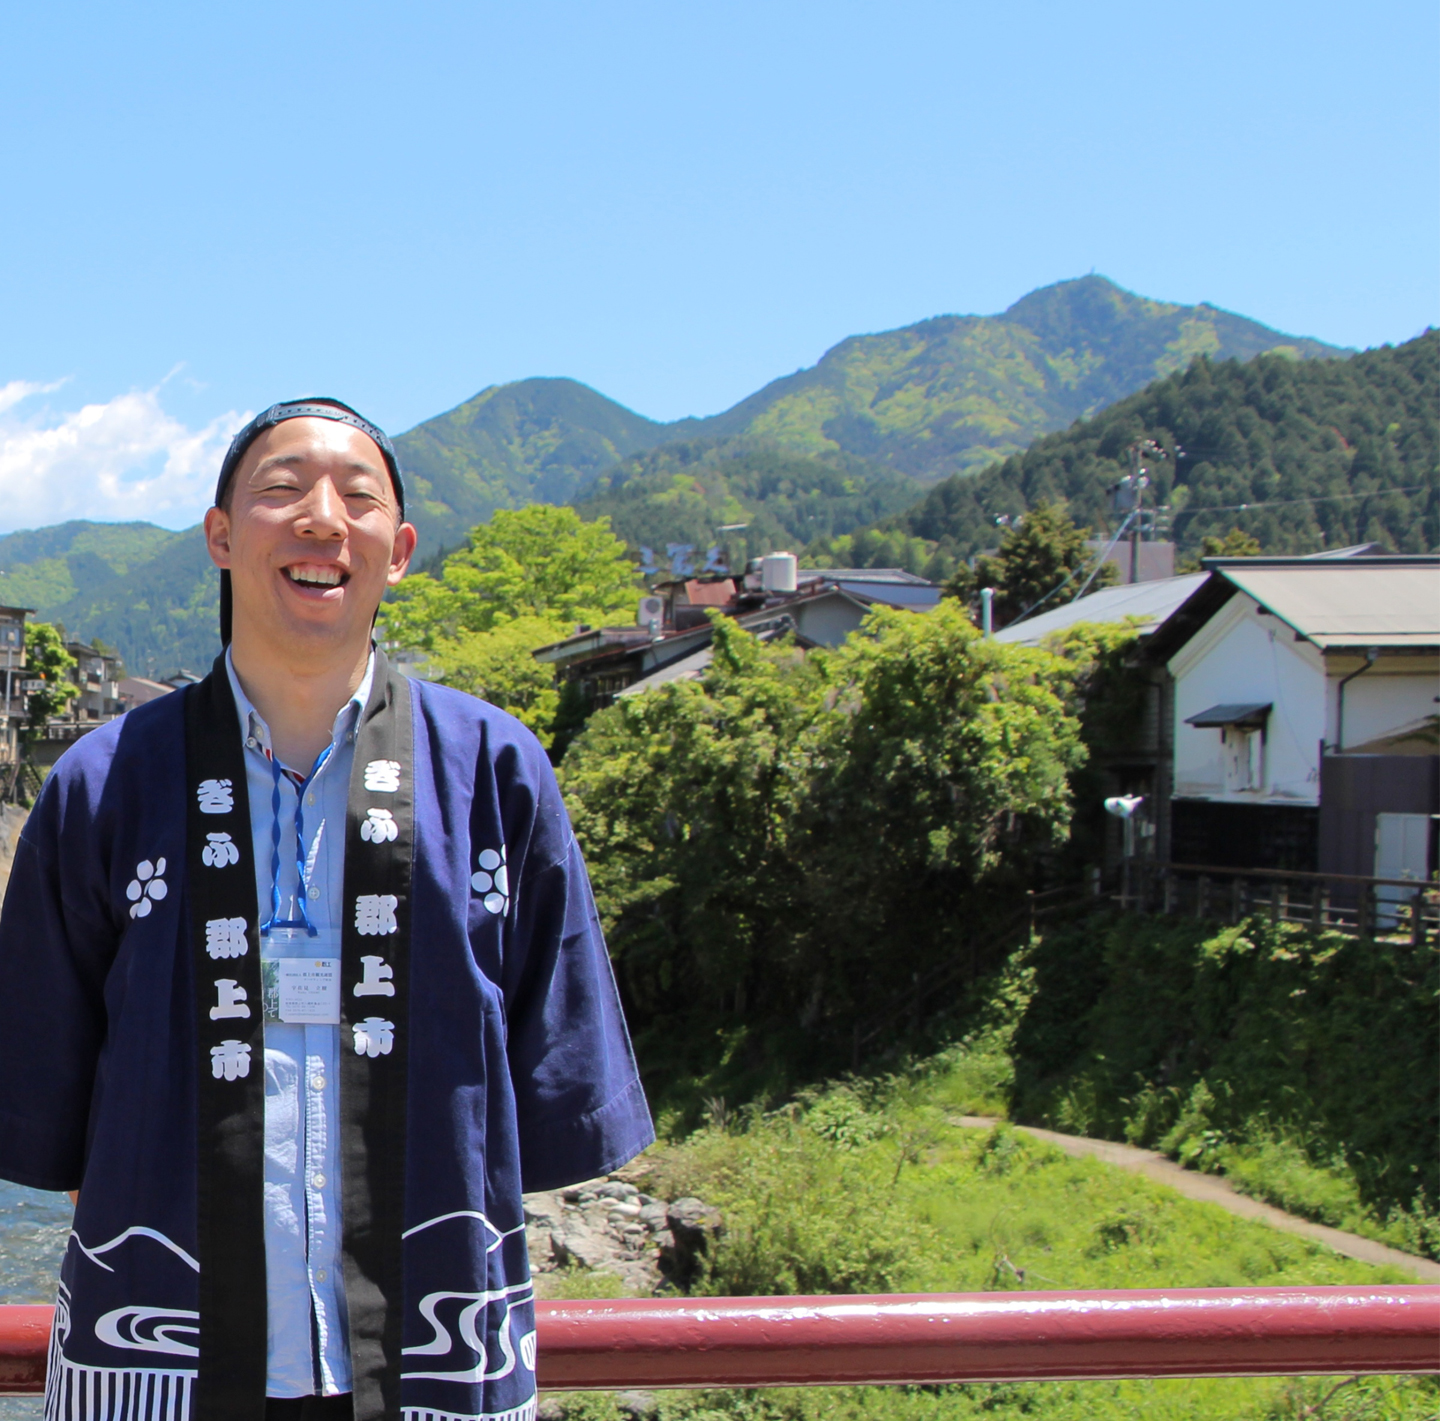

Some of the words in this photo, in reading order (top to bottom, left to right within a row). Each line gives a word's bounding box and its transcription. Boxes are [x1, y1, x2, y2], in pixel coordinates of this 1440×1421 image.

[196, 778, 240, 869] ぎふ
[360, 759, 402, 845] ぎふ
[205, 916, 252, 1082] 郡上市
[351, 893, 398, 1058] 郡上市
